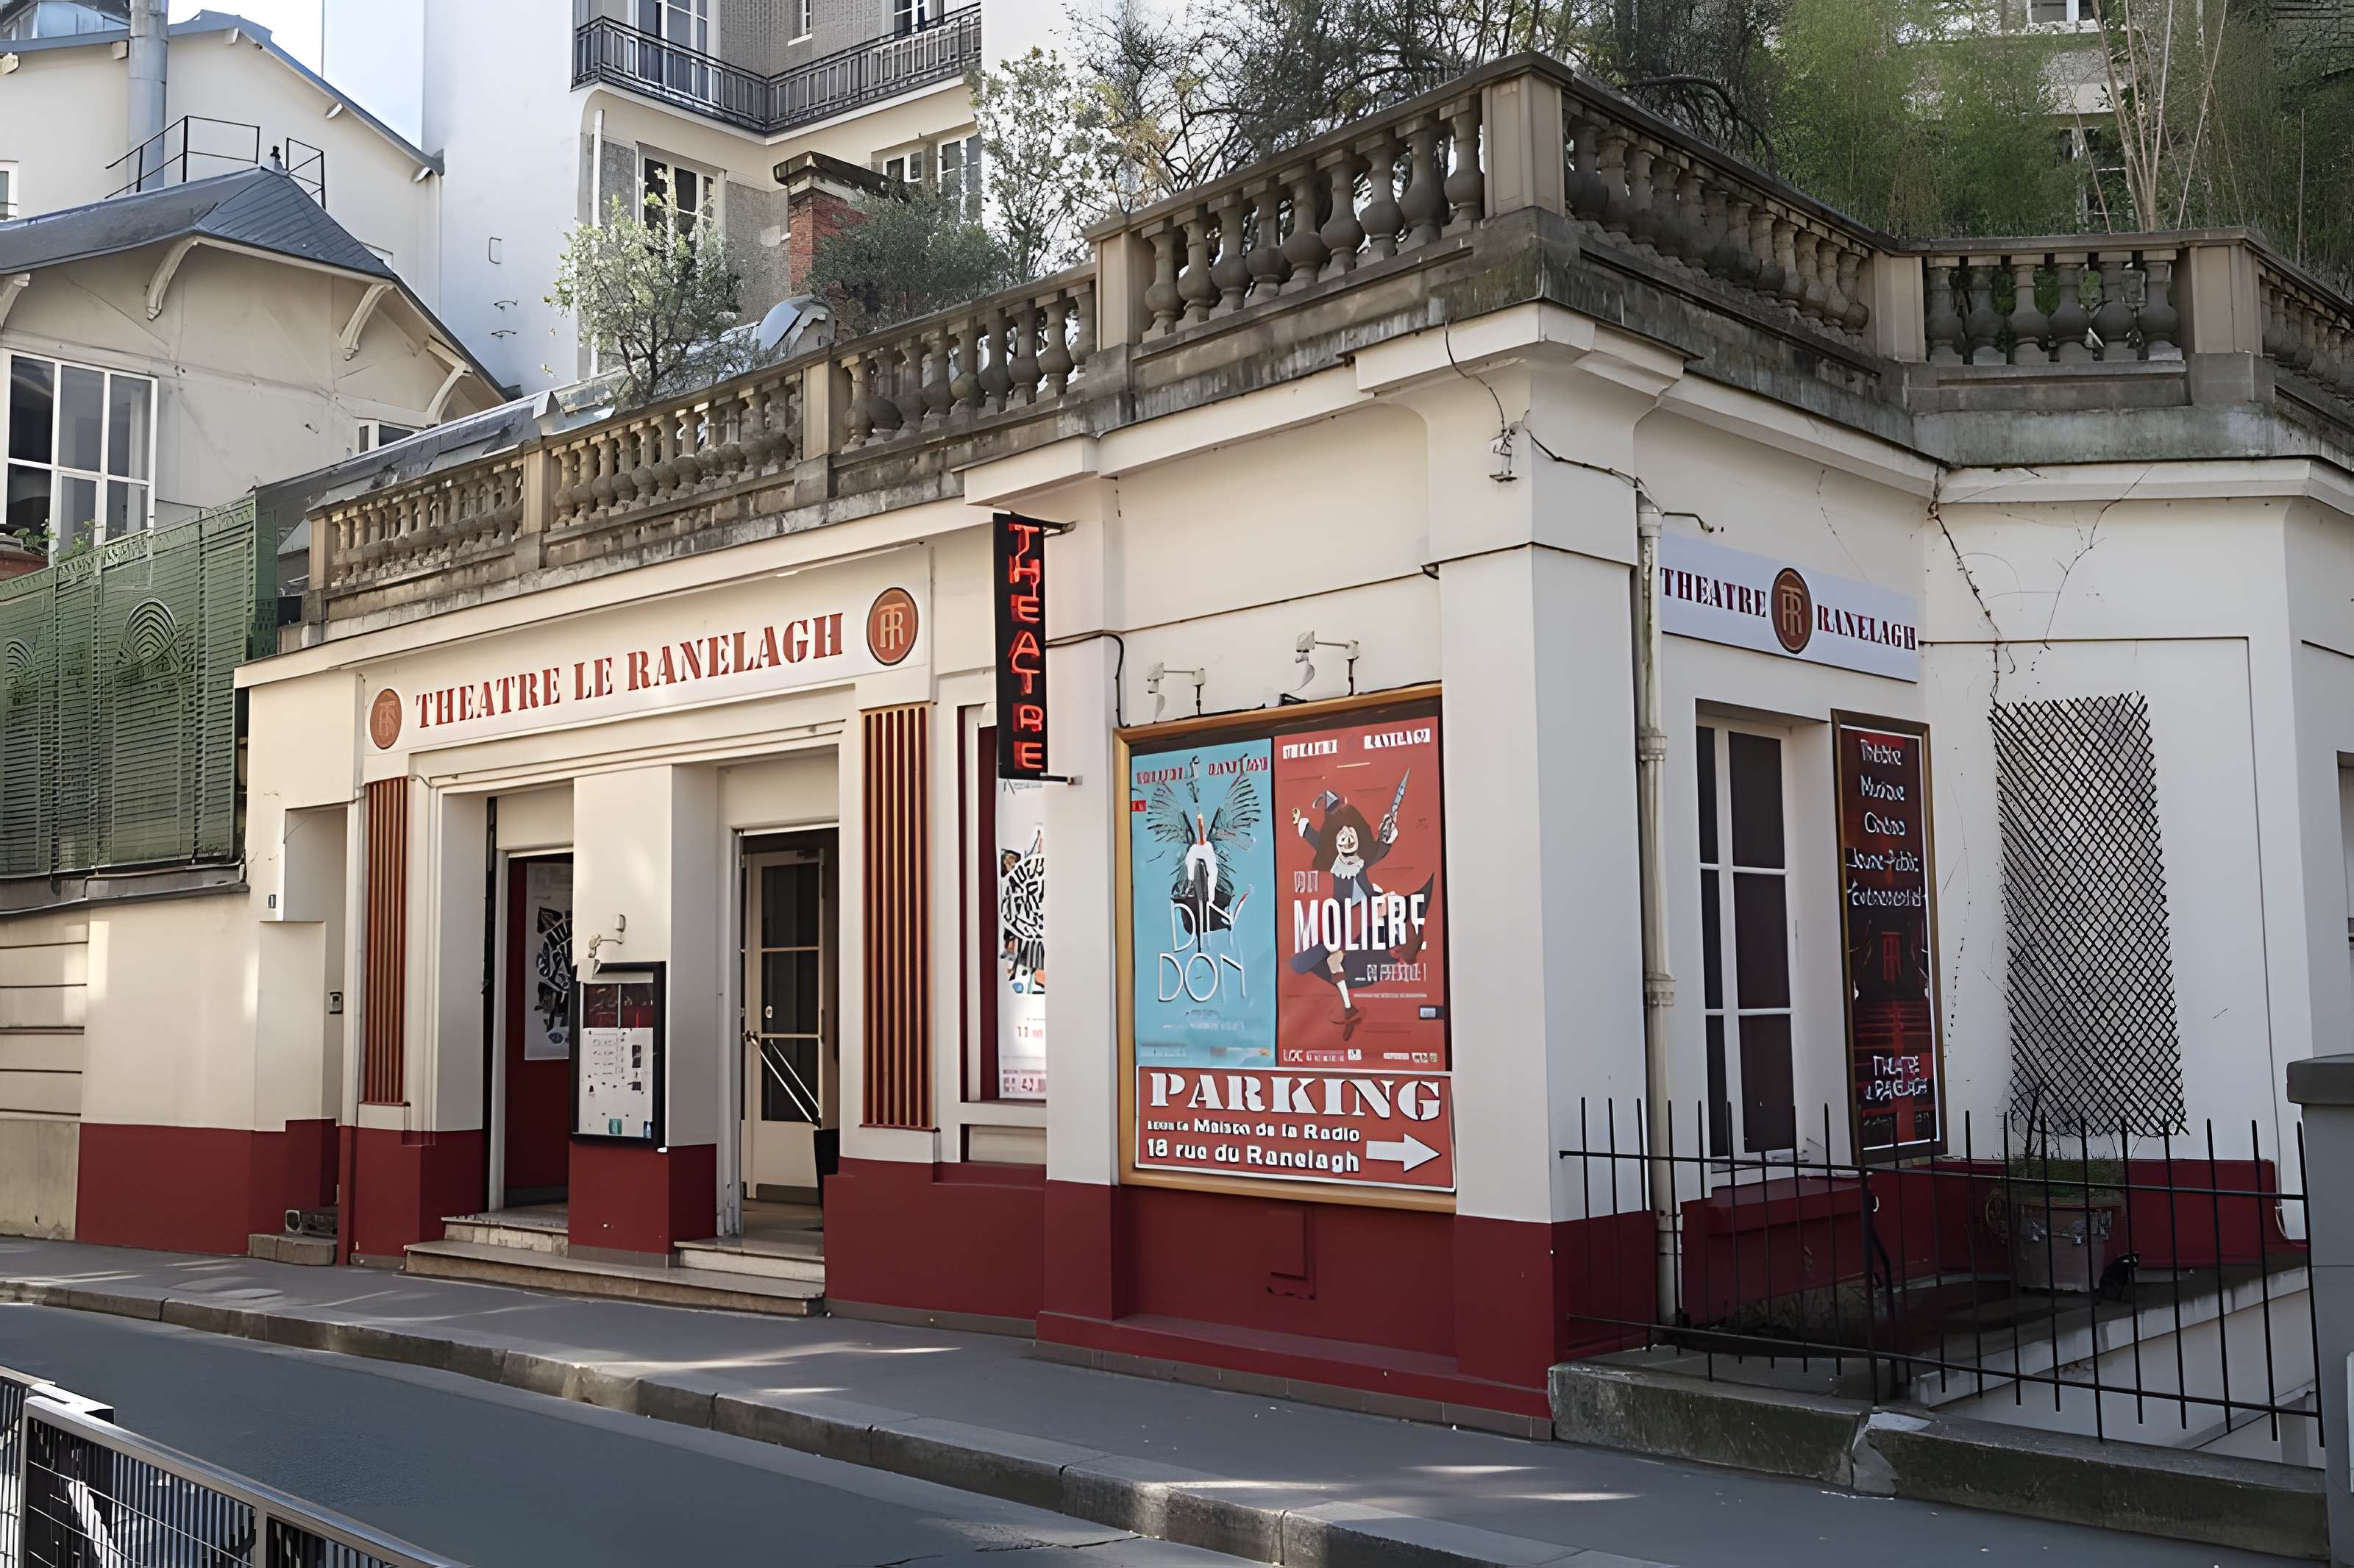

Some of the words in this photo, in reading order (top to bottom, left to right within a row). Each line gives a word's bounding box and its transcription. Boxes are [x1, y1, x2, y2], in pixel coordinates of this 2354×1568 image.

[1660, 567, 1766, 618] THEATRE
[1817, 605, 1916, 651] RANELAGH
[416, 667, 560, 728] THEATRE
[575, 657, 614, 700] LE
[627, 613, 843, 691] RANELAGH
[1008, 523, 1043, 769] THEATRE
[1158, 952, 1245, 1002] DON
[1151, 1072, 1442, 1121] PARKING
[1148, 1138, 1168, 1158] 18
[1176, 1144, 1207, 1160] rue
[1215, 1144, 1240, 1163] du
[1247, 1145, 1360, 1174] Ranelagh
[1304, 1124, 1360, 1142] Radio
